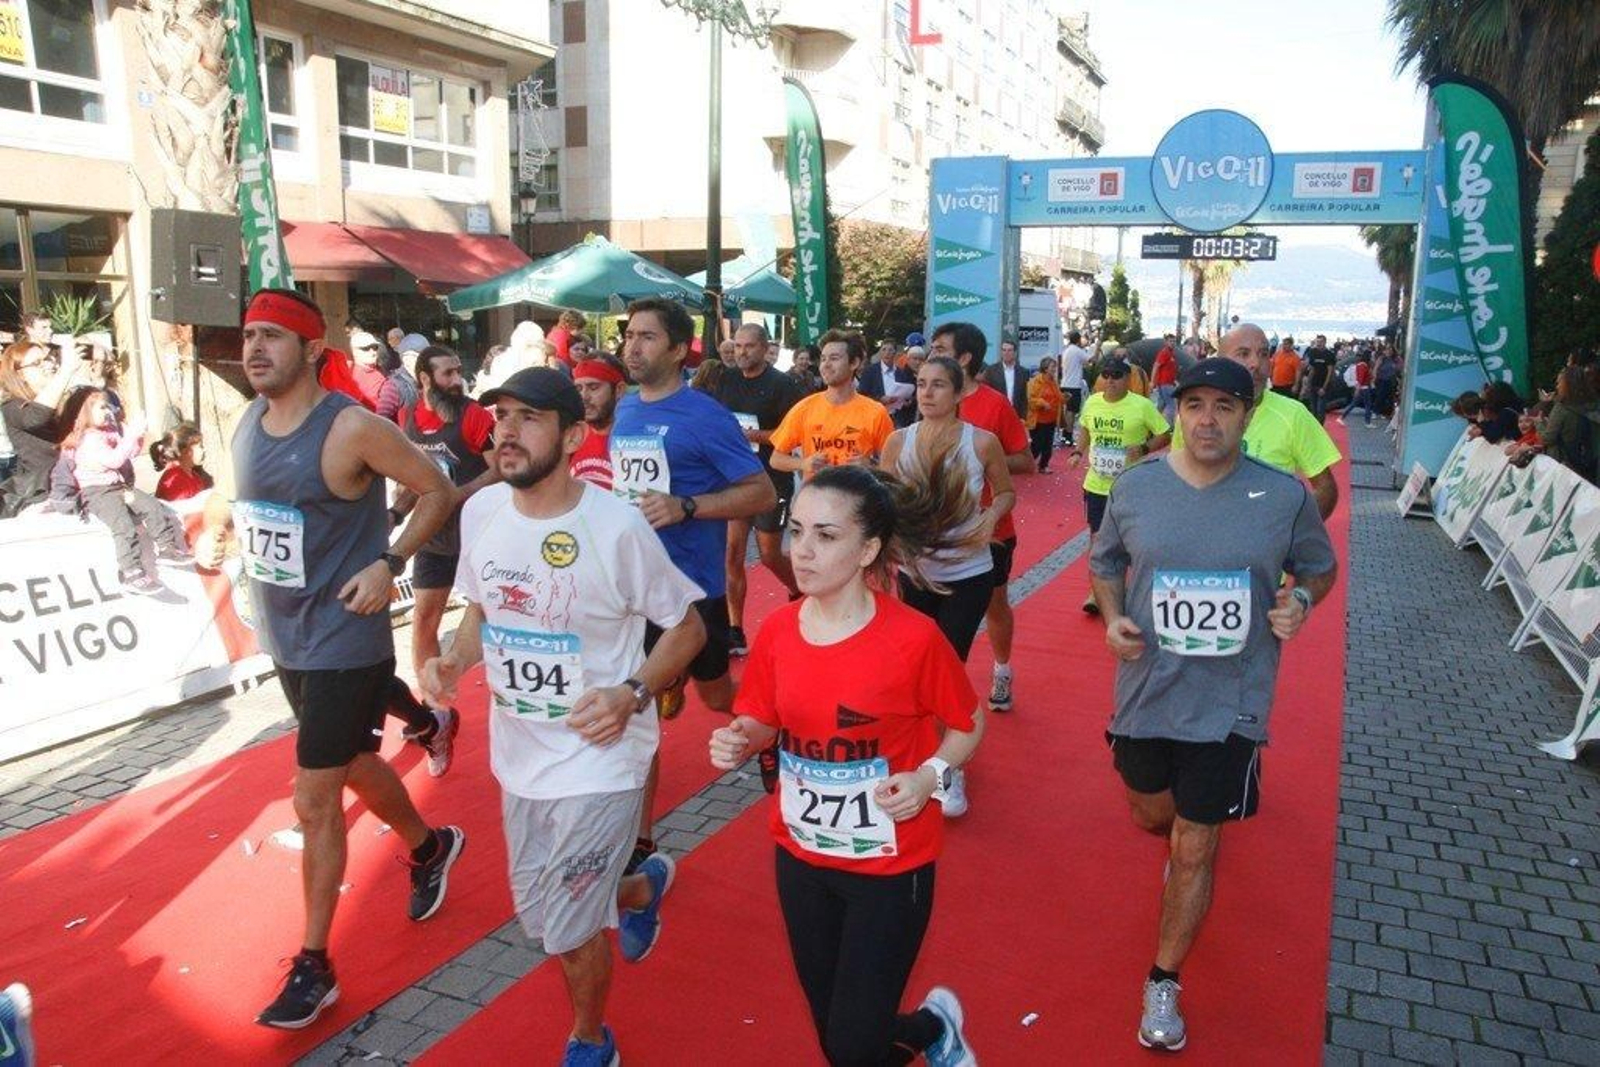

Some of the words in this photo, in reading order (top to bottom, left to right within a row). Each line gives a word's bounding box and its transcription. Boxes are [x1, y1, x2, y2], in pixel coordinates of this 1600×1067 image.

[1304, 172, 1347, 180] CONCELLO
[1047, 206, 1096, 215] CARREIRA
[1099, 204, 1146, 214] POPULAR
[1269, 203, 1326, 212] CARREIRA
[1328, 202, 1380, 211] POPULAR
[1193, 238, 1274, 257] 00:03:21
[621, 458, 659, 481] 979
[247, 526, 291, 562] 175
[481, 560, 534, 584] Correndo
[0, 568, 124, 623] CELL
[1157, 600, 1242, 630] 1028
[12, 615, 138, 674] VIGO
[502, 658, 570, 696] 194
[799, 787, 877, 829] 271
